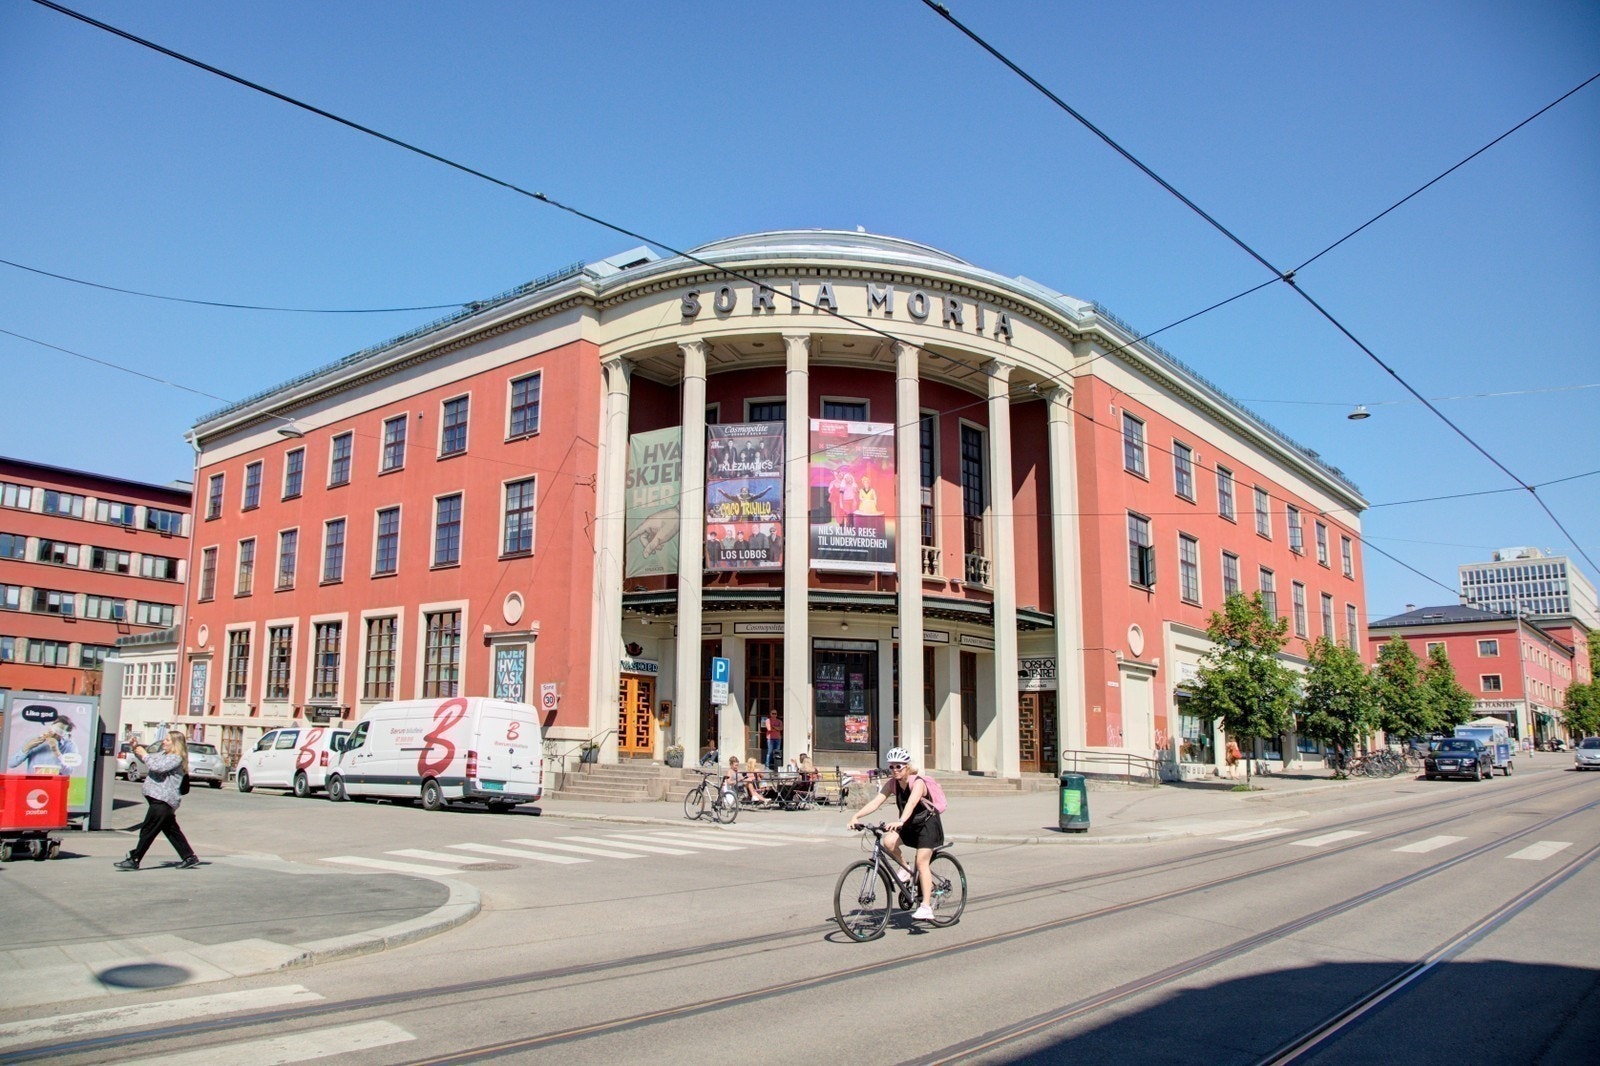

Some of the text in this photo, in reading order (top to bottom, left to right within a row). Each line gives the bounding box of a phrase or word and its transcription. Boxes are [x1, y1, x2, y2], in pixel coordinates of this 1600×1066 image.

[681, 281, 1013, 340] SORIA MORIA
[725, 424, 768, 435] Cosmopolite
[643, 441, 682, 464] HVA
[721, 461, 773, 472] KLEZMATICS
[632, 485, 674, 509] HER
[741, 501, 771, 515] TRUJILLO
[818, 525, 876, 537] NILS KLIMS REISE
[818, 536, 888, 549] TIL UNDERVERDENEN
[721, 549, 767, 560] LOS LOBOS
[716, 661, 725, 679] P
[545, 696, 553, 704] 30
[25, 709, 39, 717] Like
[26, 808, 48, 816] posten
